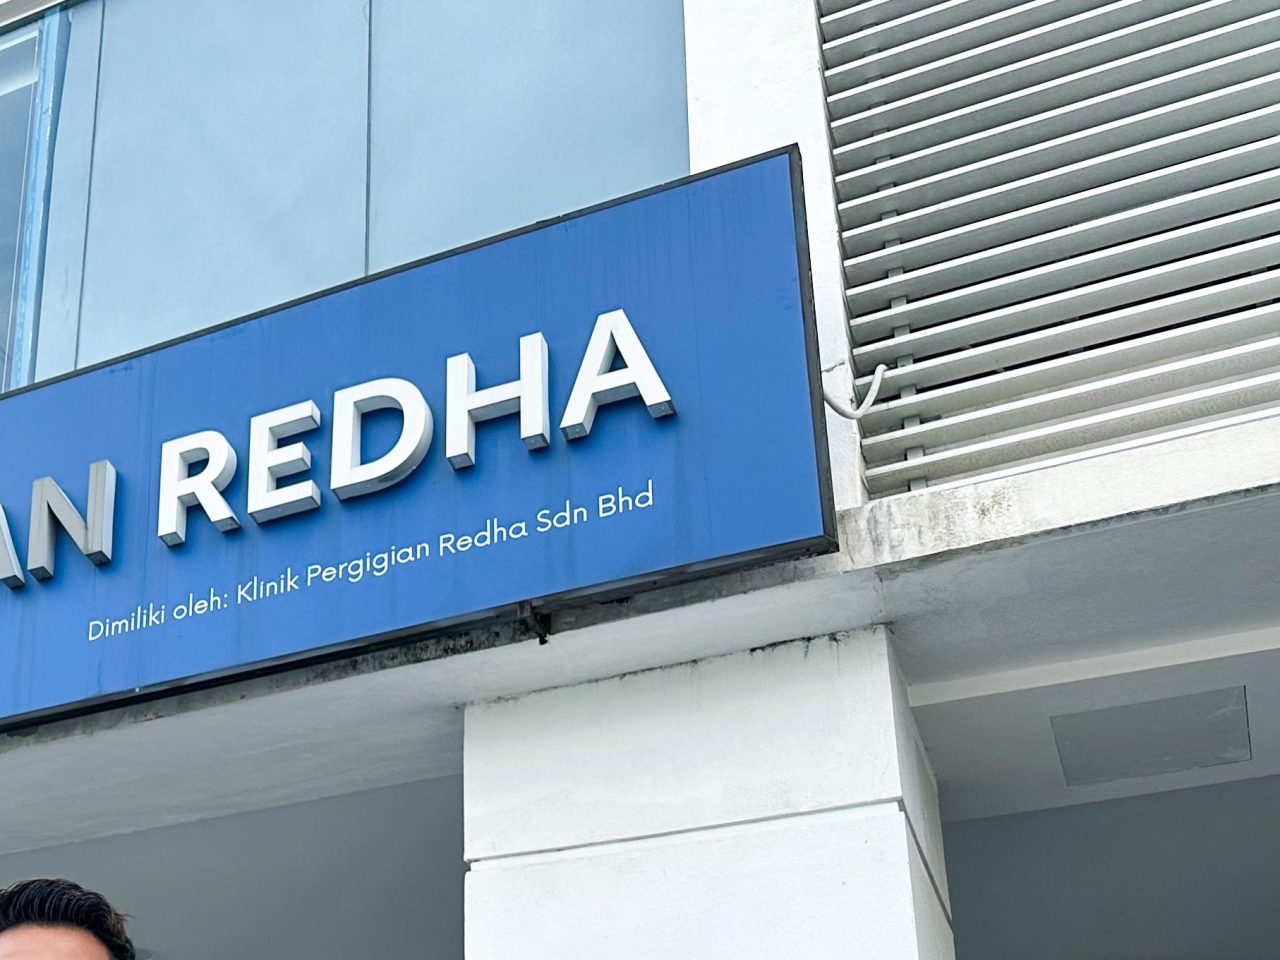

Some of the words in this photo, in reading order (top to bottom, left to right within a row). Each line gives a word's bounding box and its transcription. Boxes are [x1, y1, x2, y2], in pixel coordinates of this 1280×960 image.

[157, 308, 676, 547] REDHA
[87, 593, 166, 641] Dimiliki
[172, 586, 228, 621] oleh:
[237, 566, 299, 605] Klinik
[306, 542, 430, 587] Pergigian
[438, 517, 529, 557] Redha
[536, 500, 588, 533] Sdn
[597, 479, 654, 519] Bhd
